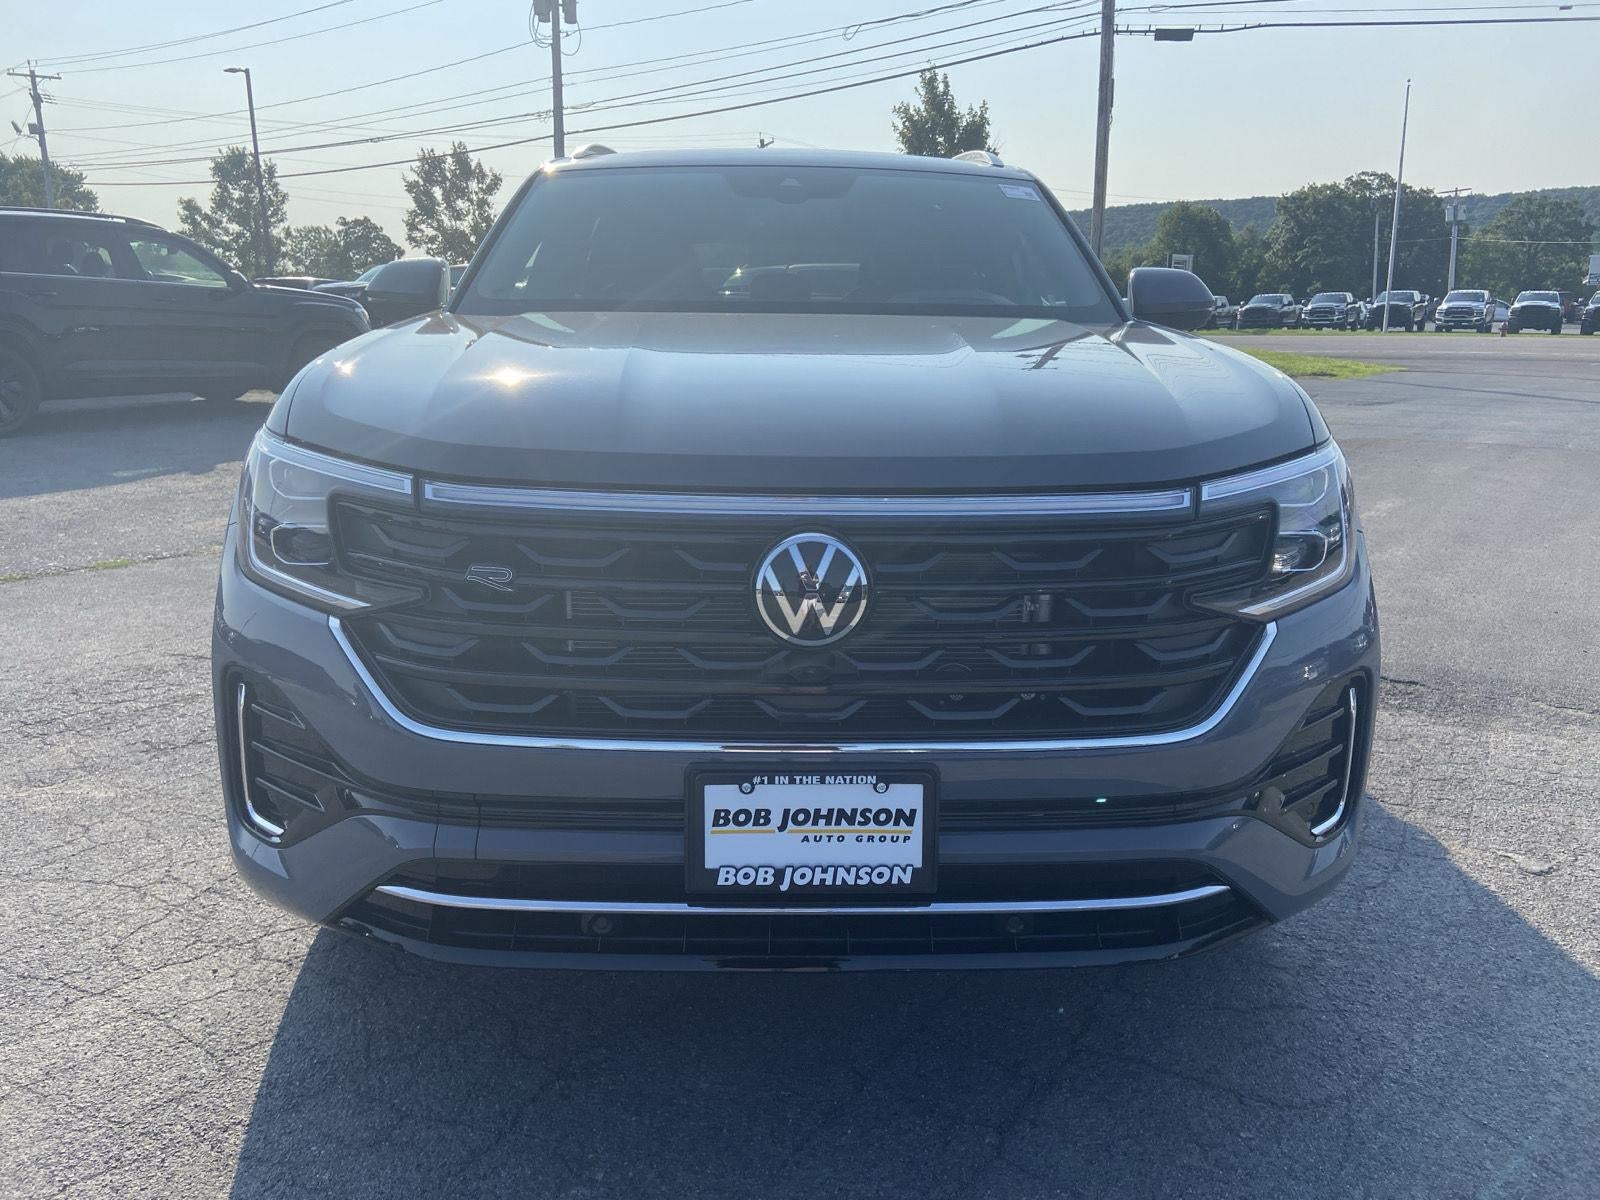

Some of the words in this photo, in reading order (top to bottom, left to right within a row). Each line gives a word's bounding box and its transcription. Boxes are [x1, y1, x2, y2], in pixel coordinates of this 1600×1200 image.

[752, 776, 768, 785] #1
[774, 775, 789, 785] IN
[793, 775, 821, 785] THE
[825, 775, 877, 785] NATION
[712, 808, 772, 828] BOB
[777, 808, 917, 832] JOHNSON
[801, 835, 845, 843] AUTO
[855, 835, 911, 843] GROUP
[717, 866, 775, 886] BOB
[779, 866, 913, 892] JOHNSON
